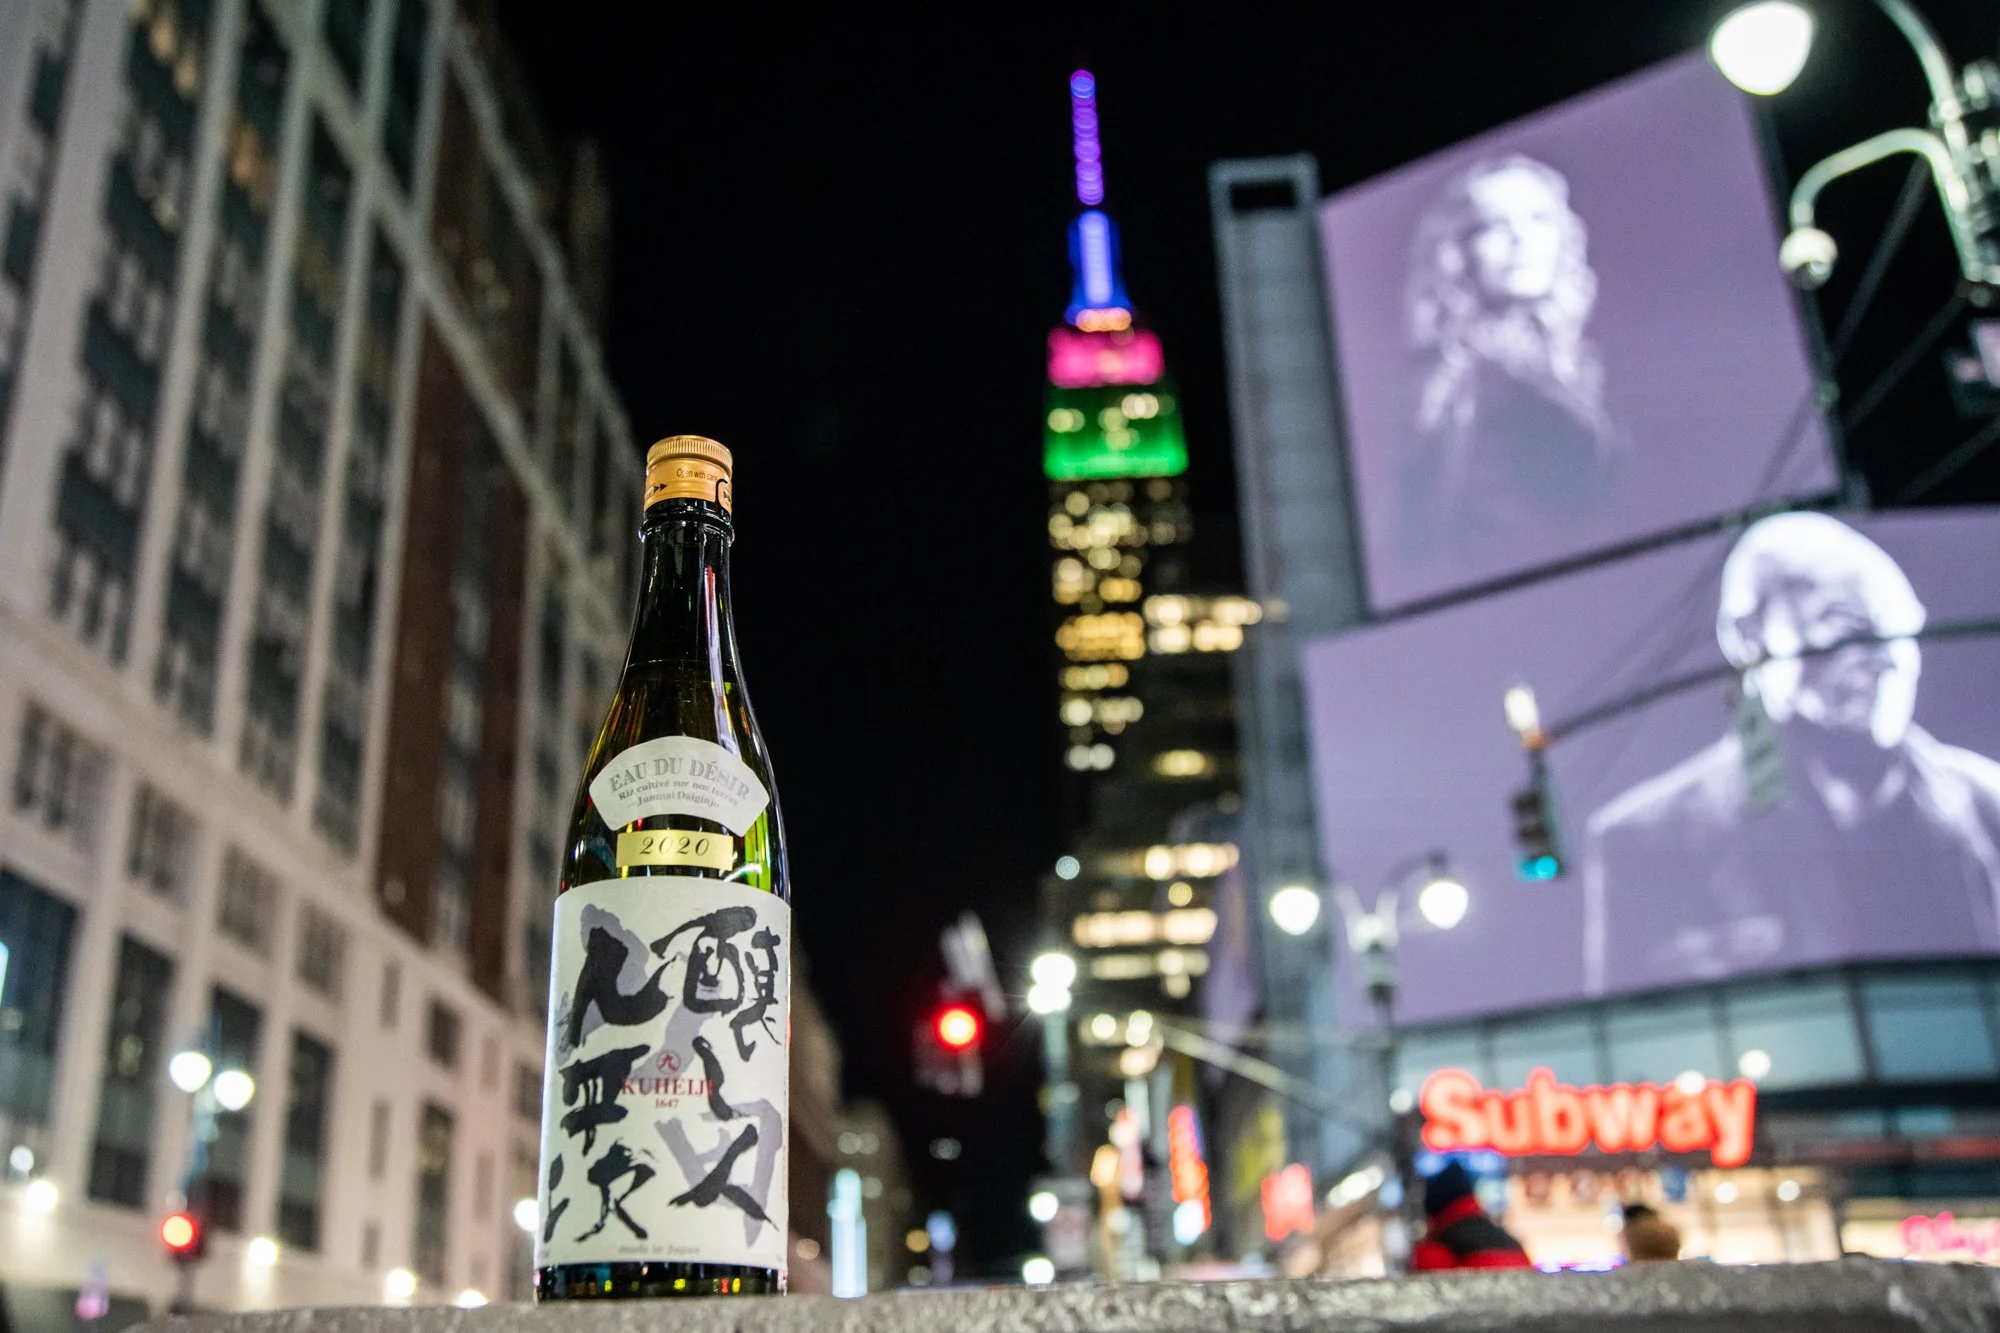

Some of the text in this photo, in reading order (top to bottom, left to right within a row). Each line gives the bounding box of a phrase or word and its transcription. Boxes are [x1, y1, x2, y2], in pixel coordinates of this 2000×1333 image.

[694, 471, 706, 479] with
[609, 757, 750, 800] EAU DU DÉSIR
[672, 780, 689, 788] sur
[640, 836, 710, 856] 2020
[621, 1077, 714, 1097] KUHEIJI
[655, 1099, 679, 1109] 1647
[1419, 1068, 1757, 1168] Subway
